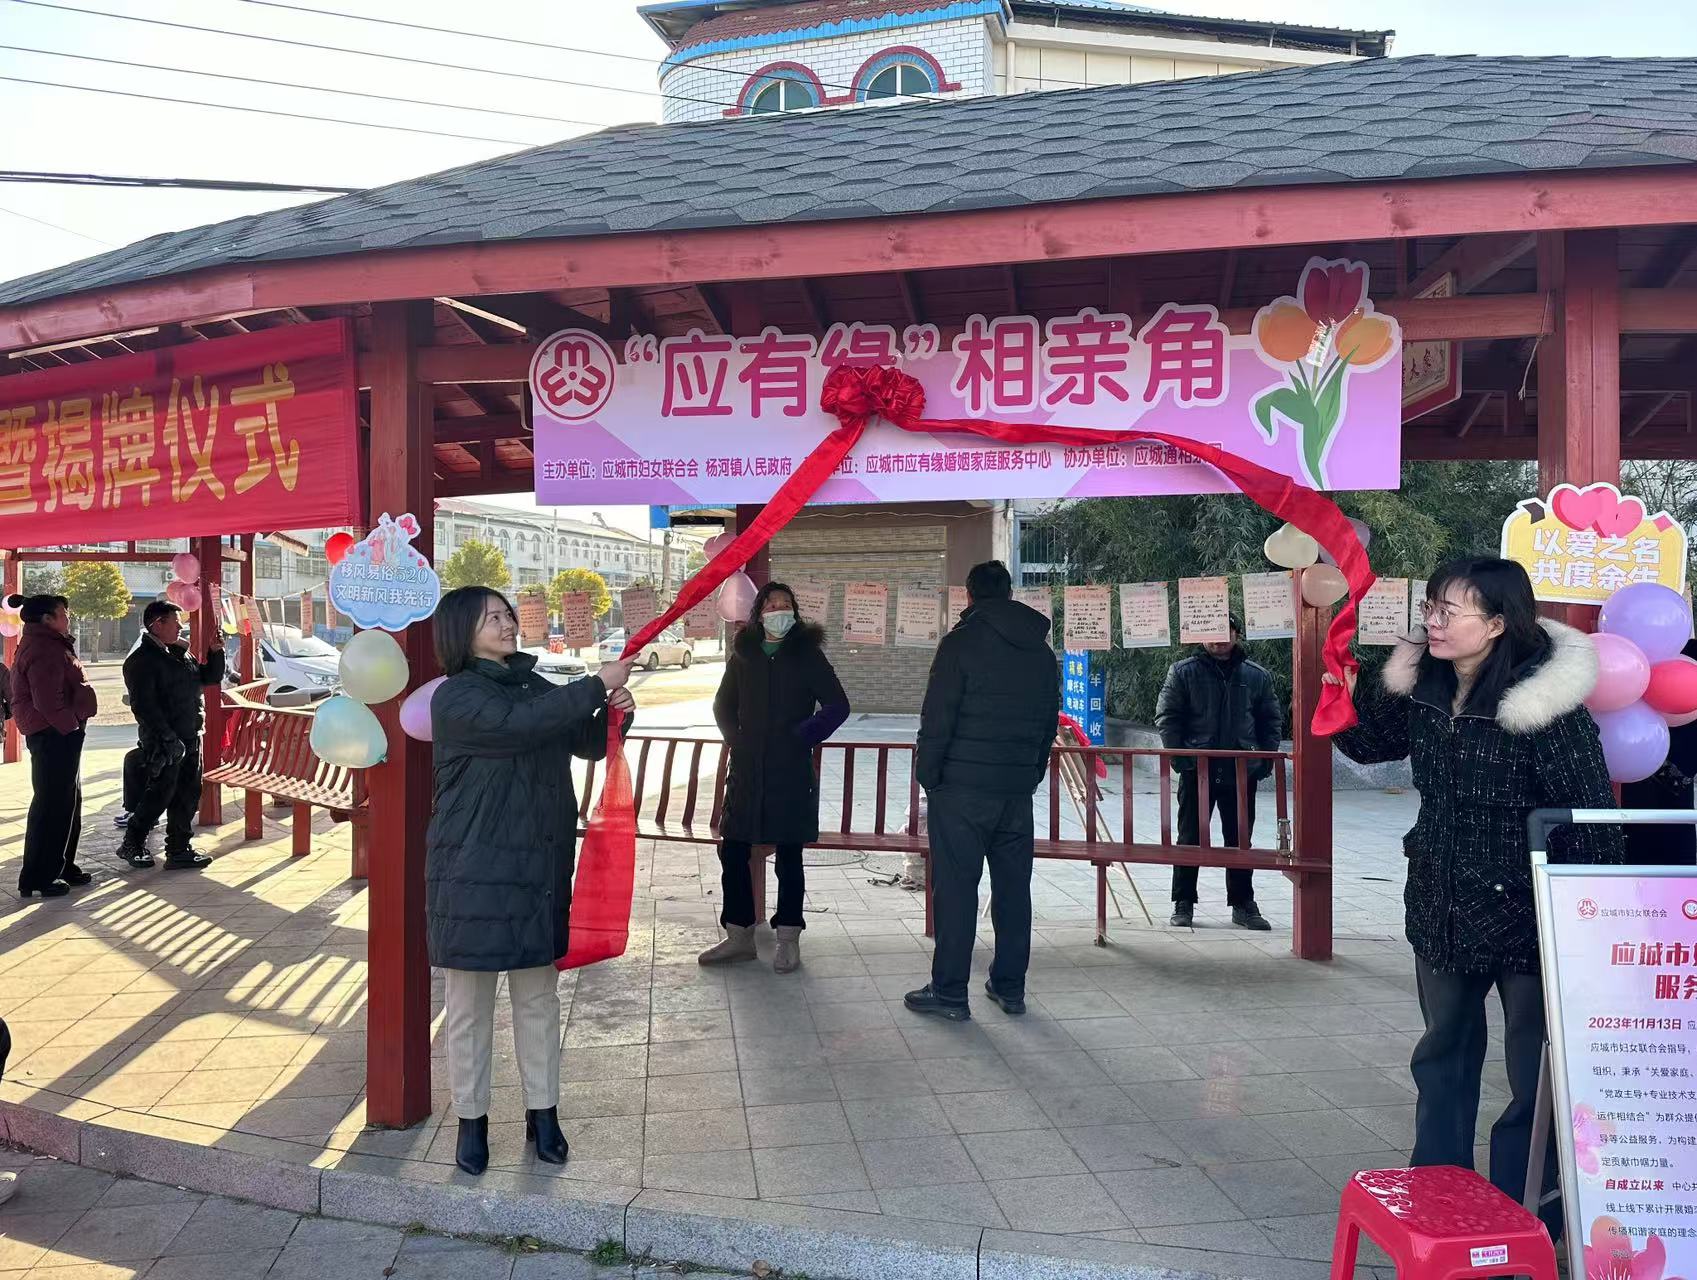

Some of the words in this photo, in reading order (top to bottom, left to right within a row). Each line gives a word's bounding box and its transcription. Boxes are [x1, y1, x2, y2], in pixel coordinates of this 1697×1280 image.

[705, 456, 792, 477] 杨河镇人民政府
[1533, 528, 1661, 564] 以爱之名
[341, 562, 428, 584] 移风易俗520
[335, 585, 433, 607] 文明新风我先行
[1600, 908, 1668, 918] 应城市妇女联合会
[1588, 1017, 1682, 1030] 2023年11月13日
[1604, 1178, 1665, 1191] 自成立以来
